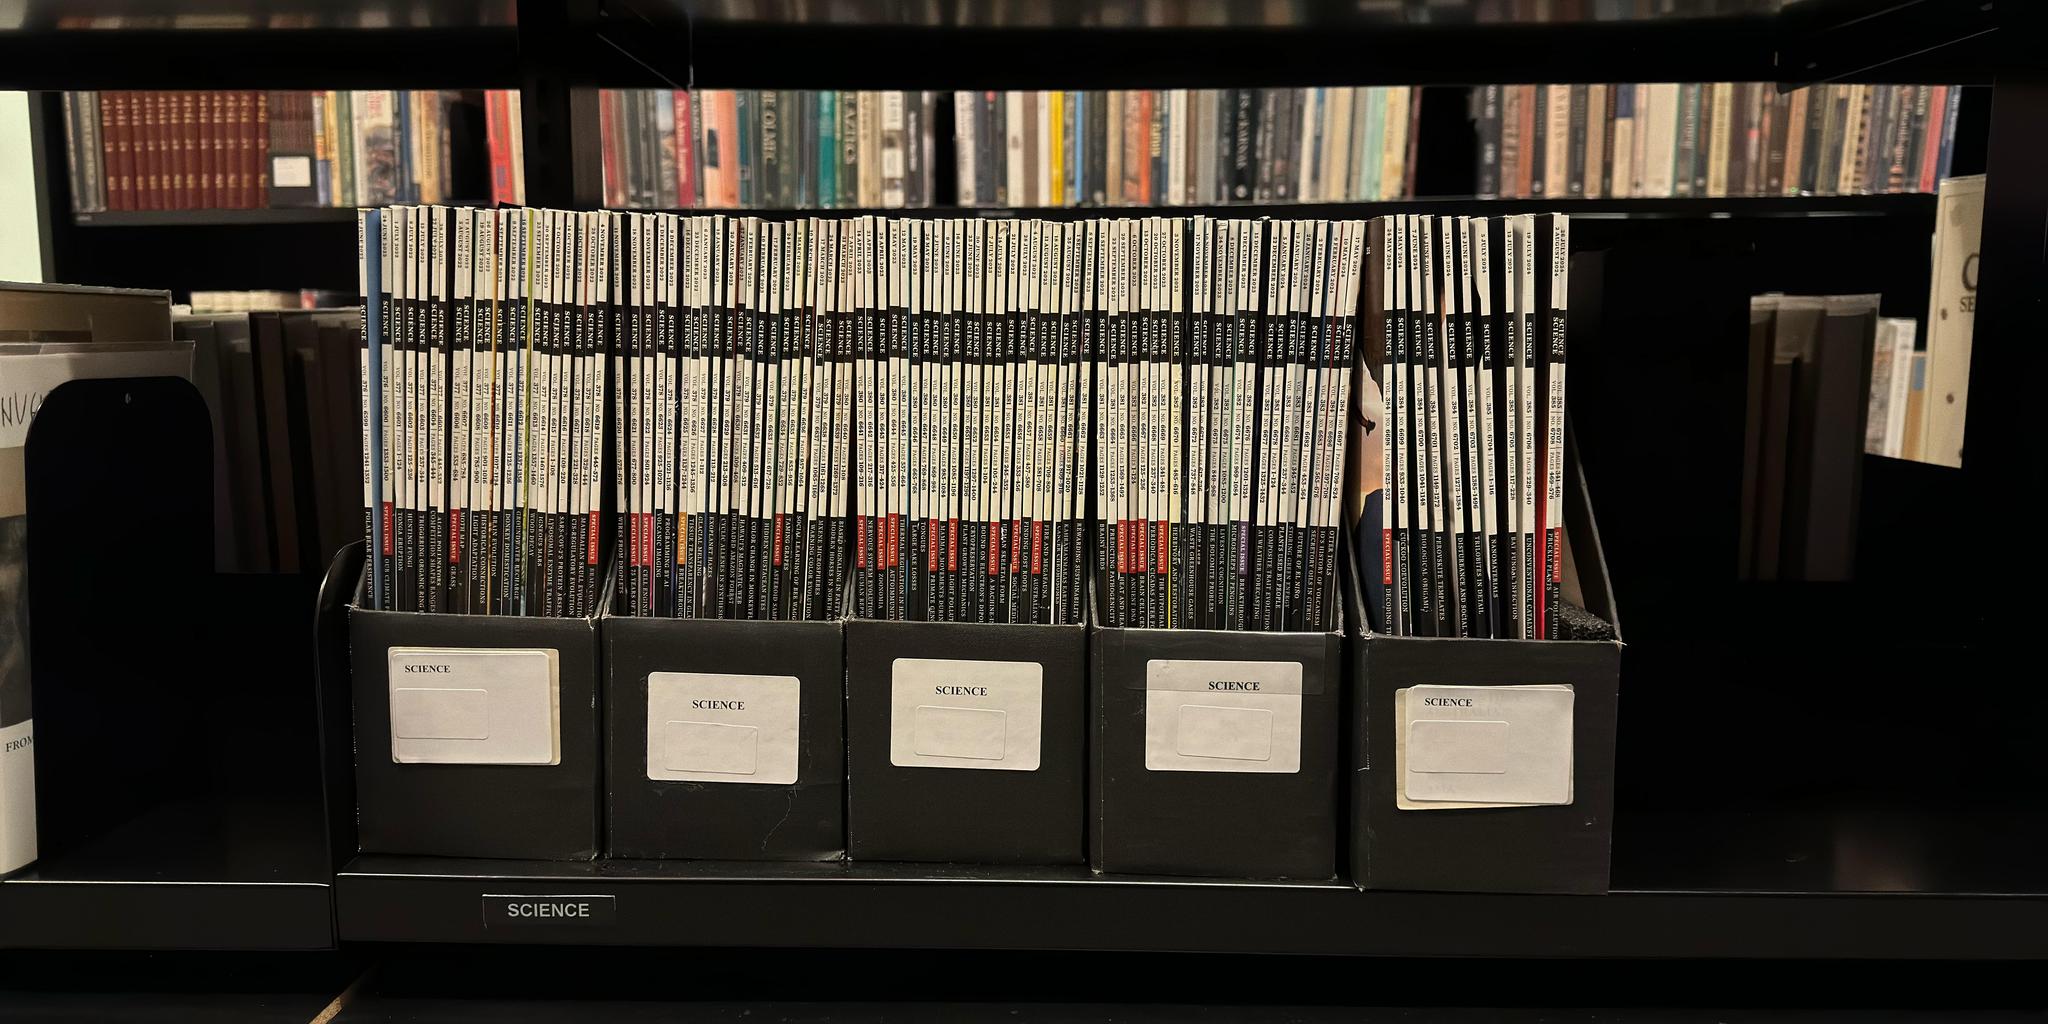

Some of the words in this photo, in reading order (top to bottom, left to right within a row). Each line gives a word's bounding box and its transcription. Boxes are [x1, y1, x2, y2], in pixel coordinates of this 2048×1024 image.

[803, 314, 811, 350] SCIENCE
[1028, 316, 1036, 352] SCIENCE
[1084, 318, 1092, 354] SCIENCE
[1238, 318, 1246, 354] SCIENCE
[1276, 324, 1285, 360] SCIENCE
[1287, 320, 1296, 356] SCIENCE
[1298, 320, 1307, 356] SCIENCE
[1310, 326, 1318, 362] SCIENCE
[1323, 324, 1333, 360] SCIENCE
[1334, 324, 1342, 360] SCIENCE
[1343, 324, 1352, 360] SCIENCE
[1427, 322, 1435, 360] SCIENCE
[404, 664, 451, 673] SCIENCE
[1208, 680, 1260, 691] SCIENCE
[692, 699, 745, 711] SCIENCE
[935, 685, 988, 697] SCIENCE
[1424, 697, 1473, 707] SCIENCE
[507, 903, 590, 918] SCIENCE
